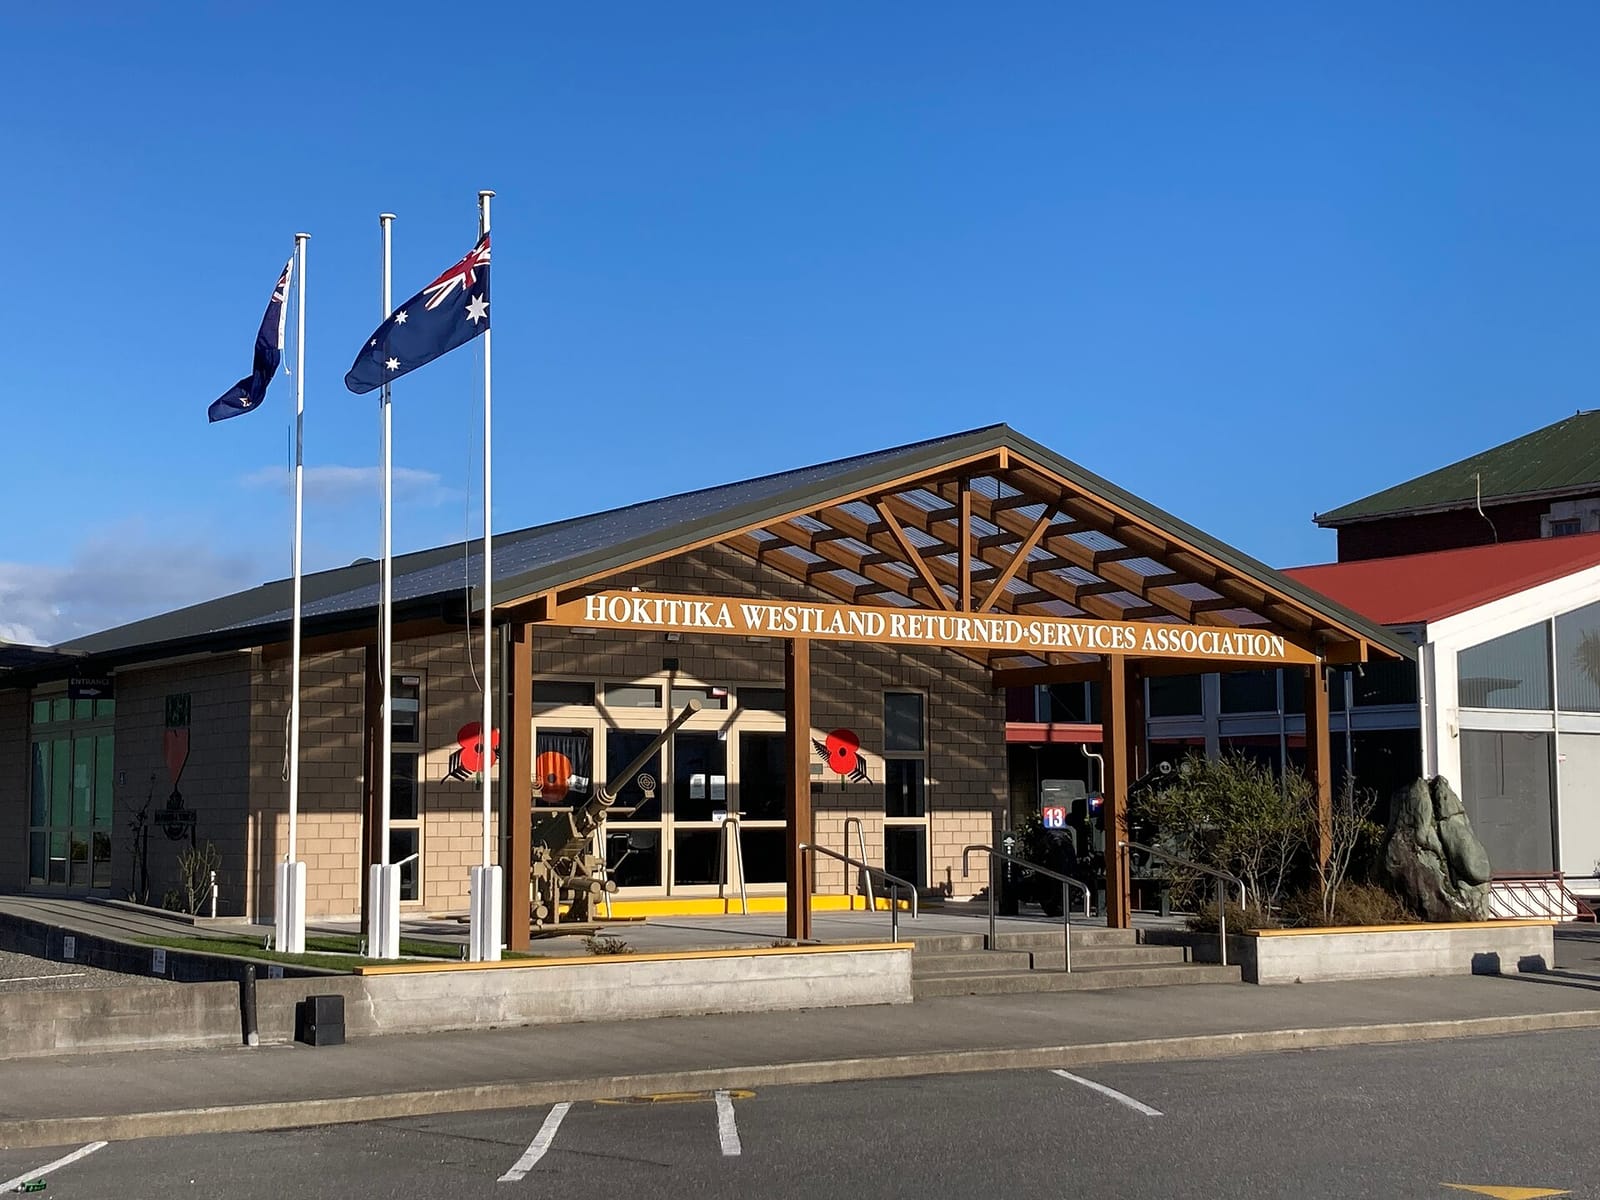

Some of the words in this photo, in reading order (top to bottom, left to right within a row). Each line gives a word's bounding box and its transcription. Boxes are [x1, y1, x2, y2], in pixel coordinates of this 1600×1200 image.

[585, 595, 735, 628] HOKITIKA
[740, 604, 885, 636] WESTLAND
[890, 614, 1022, 644] RETURNED
[1029, 621, 1136, 648] SERVICES
[1142, 628, 1285, 657] ASSOCIATION
[1047, 809, 1063, 827] 13
